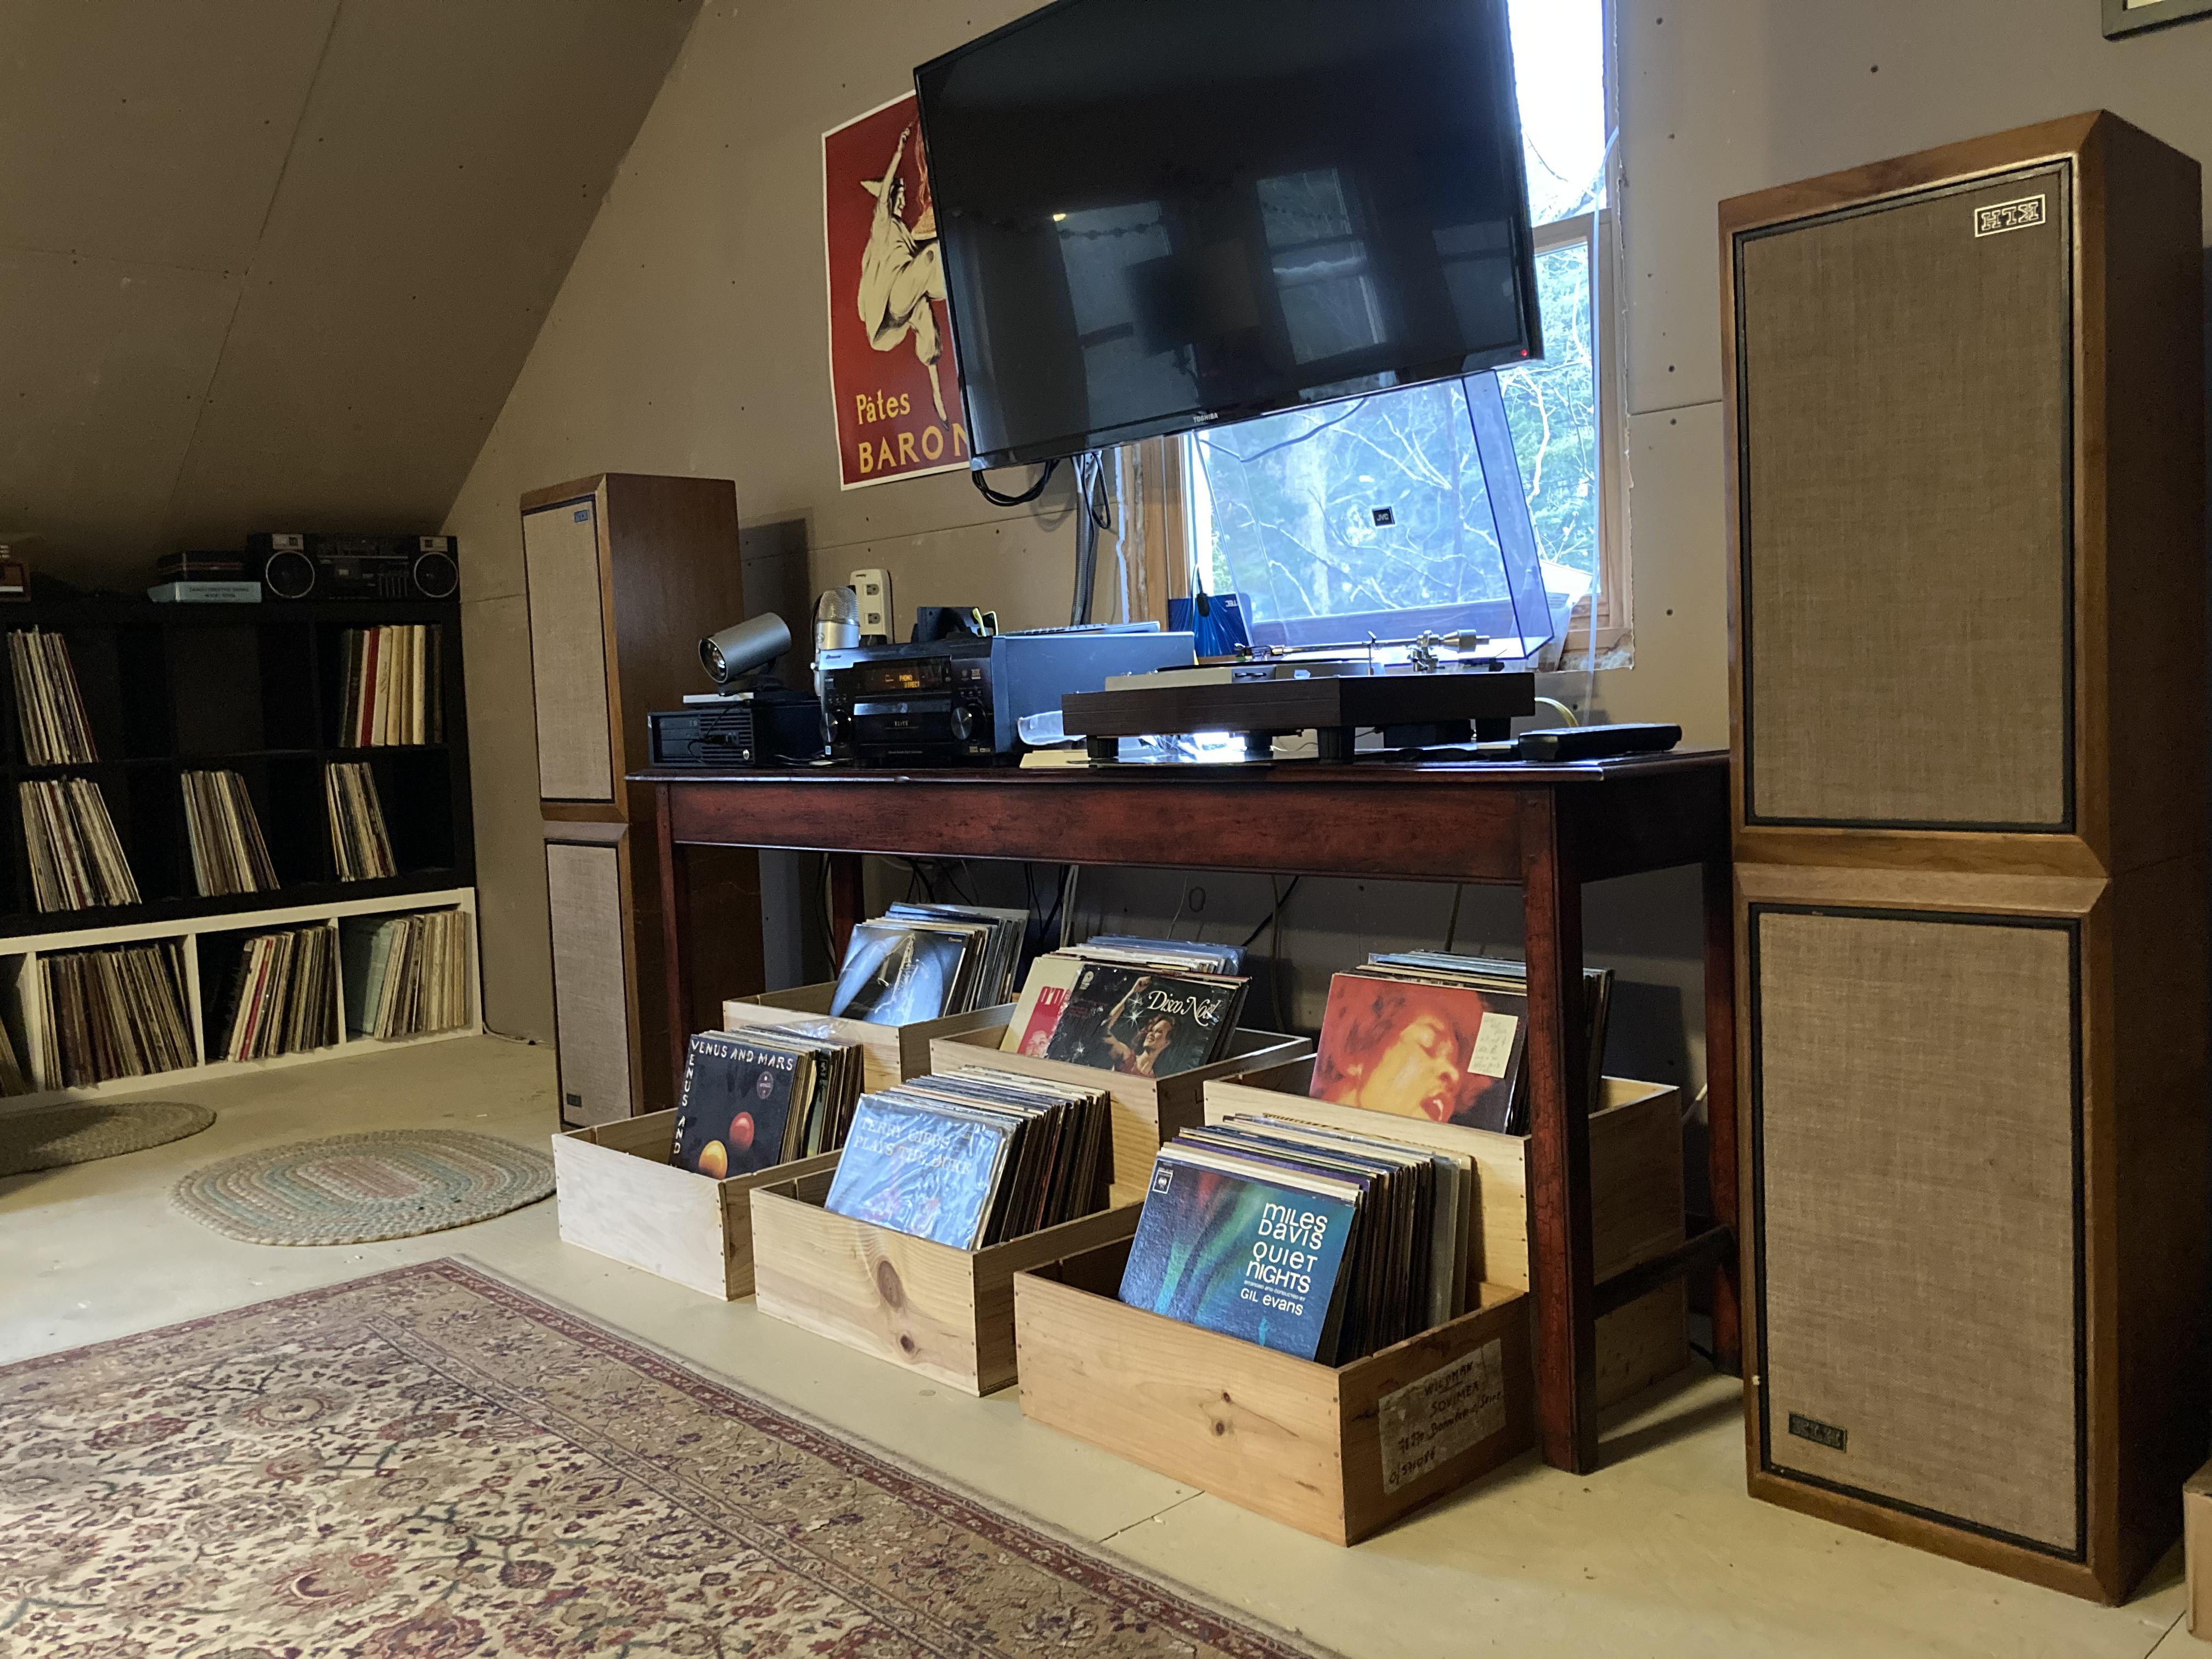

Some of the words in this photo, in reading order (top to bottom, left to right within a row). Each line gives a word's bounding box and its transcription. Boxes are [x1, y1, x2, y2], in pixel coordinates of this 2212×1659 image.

[856, 388, 911, 425] Pâtes
[1193, 412, 1218, 423] TOSHIBA
[1376, 513, 1389, 521] JVC
[1147, 990, 1183, 1014] Disco
[691, 1039, 728, 1058] VENUS
[730, 1048, 754, 1063] AND
[758, 1053, 794, 1071] MARS
[861, 1117, 904, 1138] TERRY
[907, 1128, 951, 1149] GIBBS
[853, 1136, 894, 1156] PLAYS
[899, 1146, 928, 1163] THE
[931, 1155, 972, 1175] DUKE
[1240, 1288, 1258, 1303] GIL
[1262, 1294, 1304, 1316] evans
